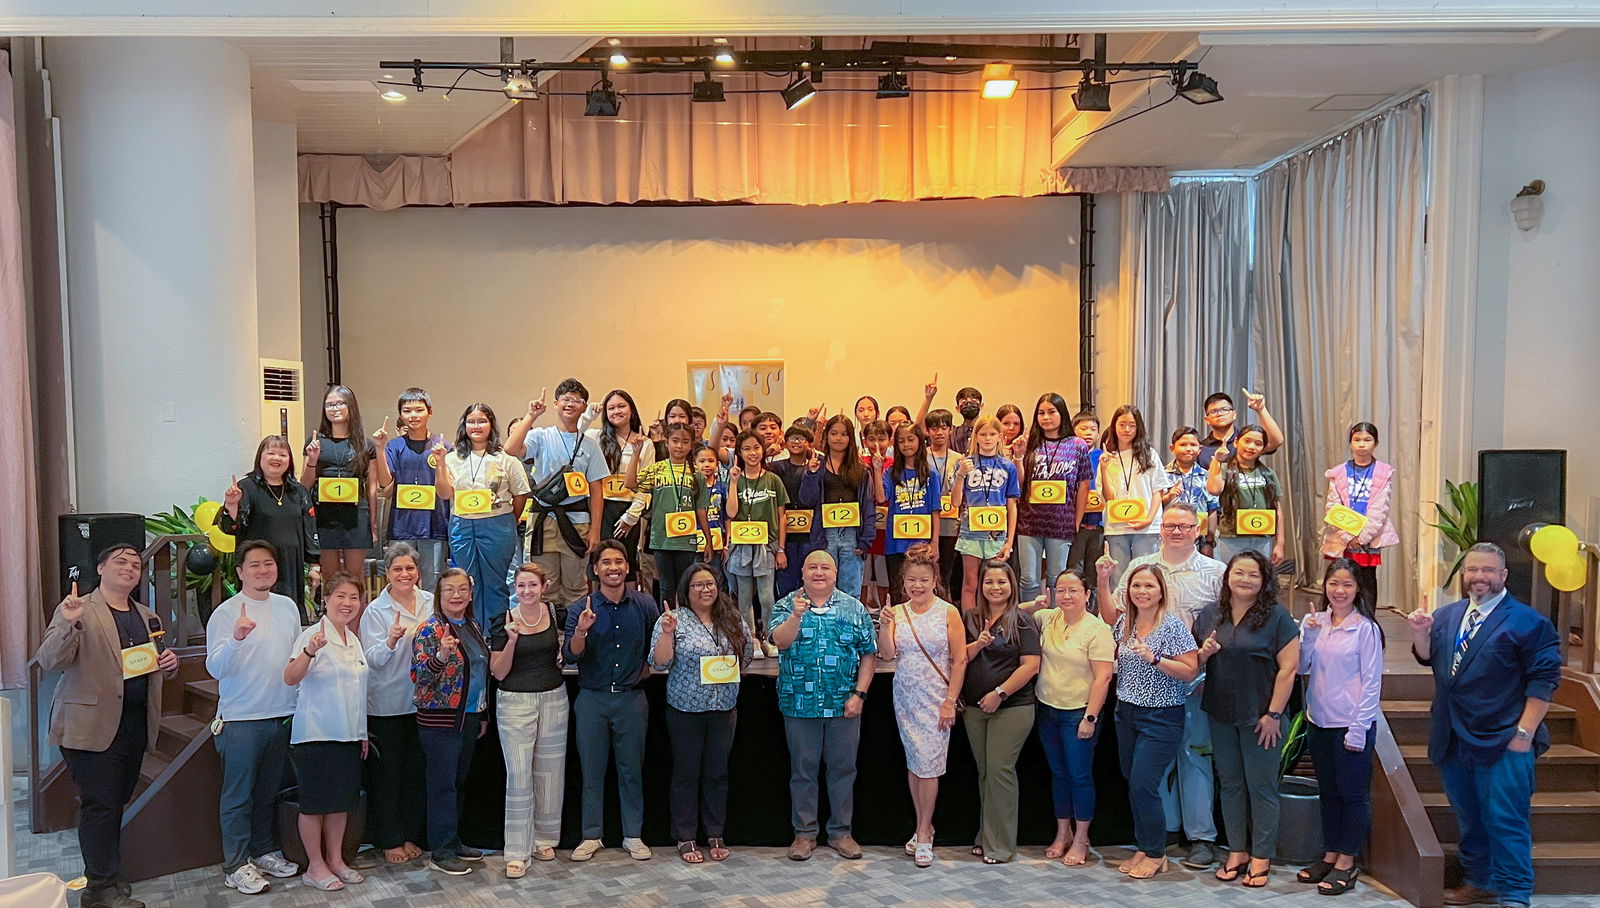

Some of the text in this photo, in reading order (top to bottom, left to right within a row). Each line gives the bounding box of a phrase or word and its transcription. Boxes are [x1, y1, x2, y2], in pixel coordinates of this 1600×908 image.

[574, 478, 582, 489] 4
[968, 467, 1008, 488] GES
[334, 485, 341, 497] 1
[607, 480, 624, 491] 17
[409, 491, 422, 503] 2
[1041, 487, 1053, 498] 8
[468, 496, 479, 507] 3
[942, 502, 952, 512] 0
[1089, 496, 1100, 506] 3
[830, 509, 850, 521] 12
[1121, 504, 1132, 516] 7
[786, 516, 807, 527] 28
[876, 512, 885, 523] 2
[977, 513, 999, 525] 10
[1250, 517, 1262, 529] 6
[1334, 511, 1359, 525] 37
[677, 518, 687, 530] 5
[901, 521, 920, 533] 11
[739, 527, 761, 537] 23
